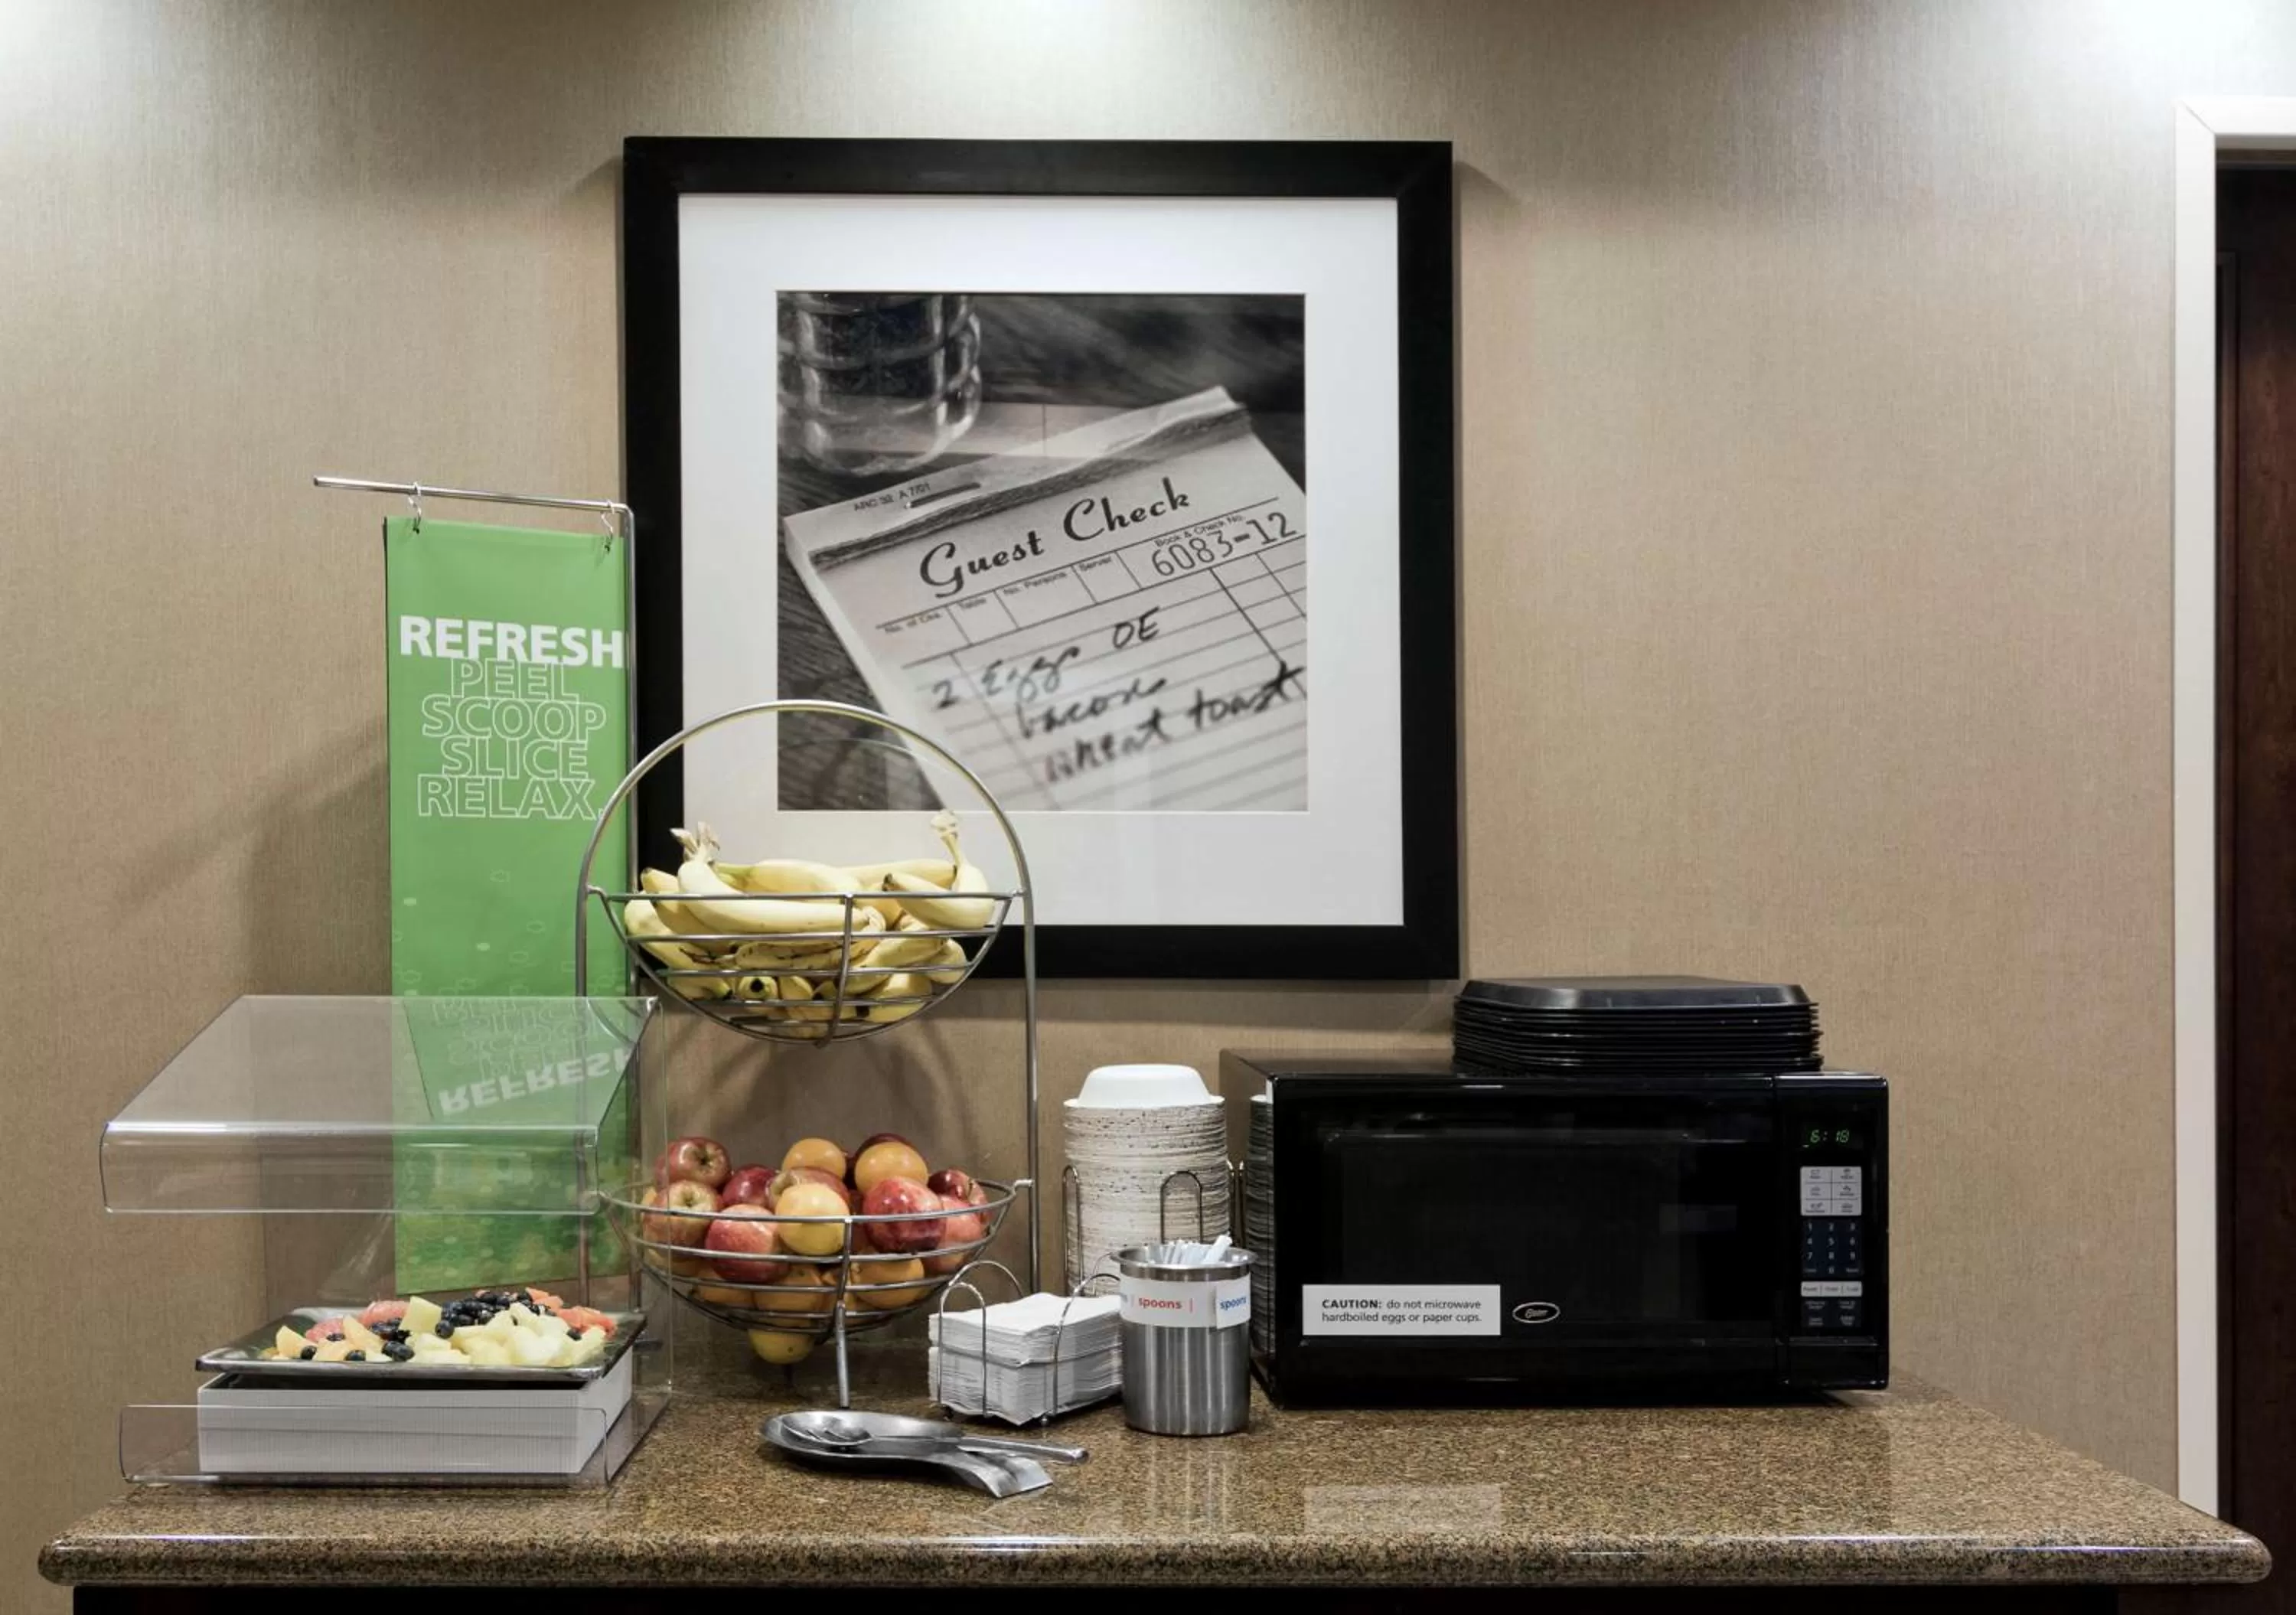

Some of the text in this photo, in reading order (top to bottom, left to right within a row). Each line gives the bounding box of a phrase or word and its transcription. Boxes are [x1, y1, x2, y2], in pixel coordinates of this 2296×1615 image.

[920, 477, 1189, 598] Guest Check
[1151, 512, 1297, 576] 6083-12
[400, 615, 626, 668] REFRESH
[451, 658, 579, 702] PEEL
[1188, 660, 1306, 729] toast
[422, 693, 607, 742] SCOOP
[441, 737, 589, 781] SLICE
[1138, 1298, 1182, 1310] spoons
[1322, 1299, 1482, 1309] CAUTION: do not microwave
[1322, 1312, 1378, 1322] hardboiled
[1381, 1314, 1406, 1325] eggs
[1423, 1314, 1453, 1324] paper
[1456, 1314, 1482, 1324] cups.
